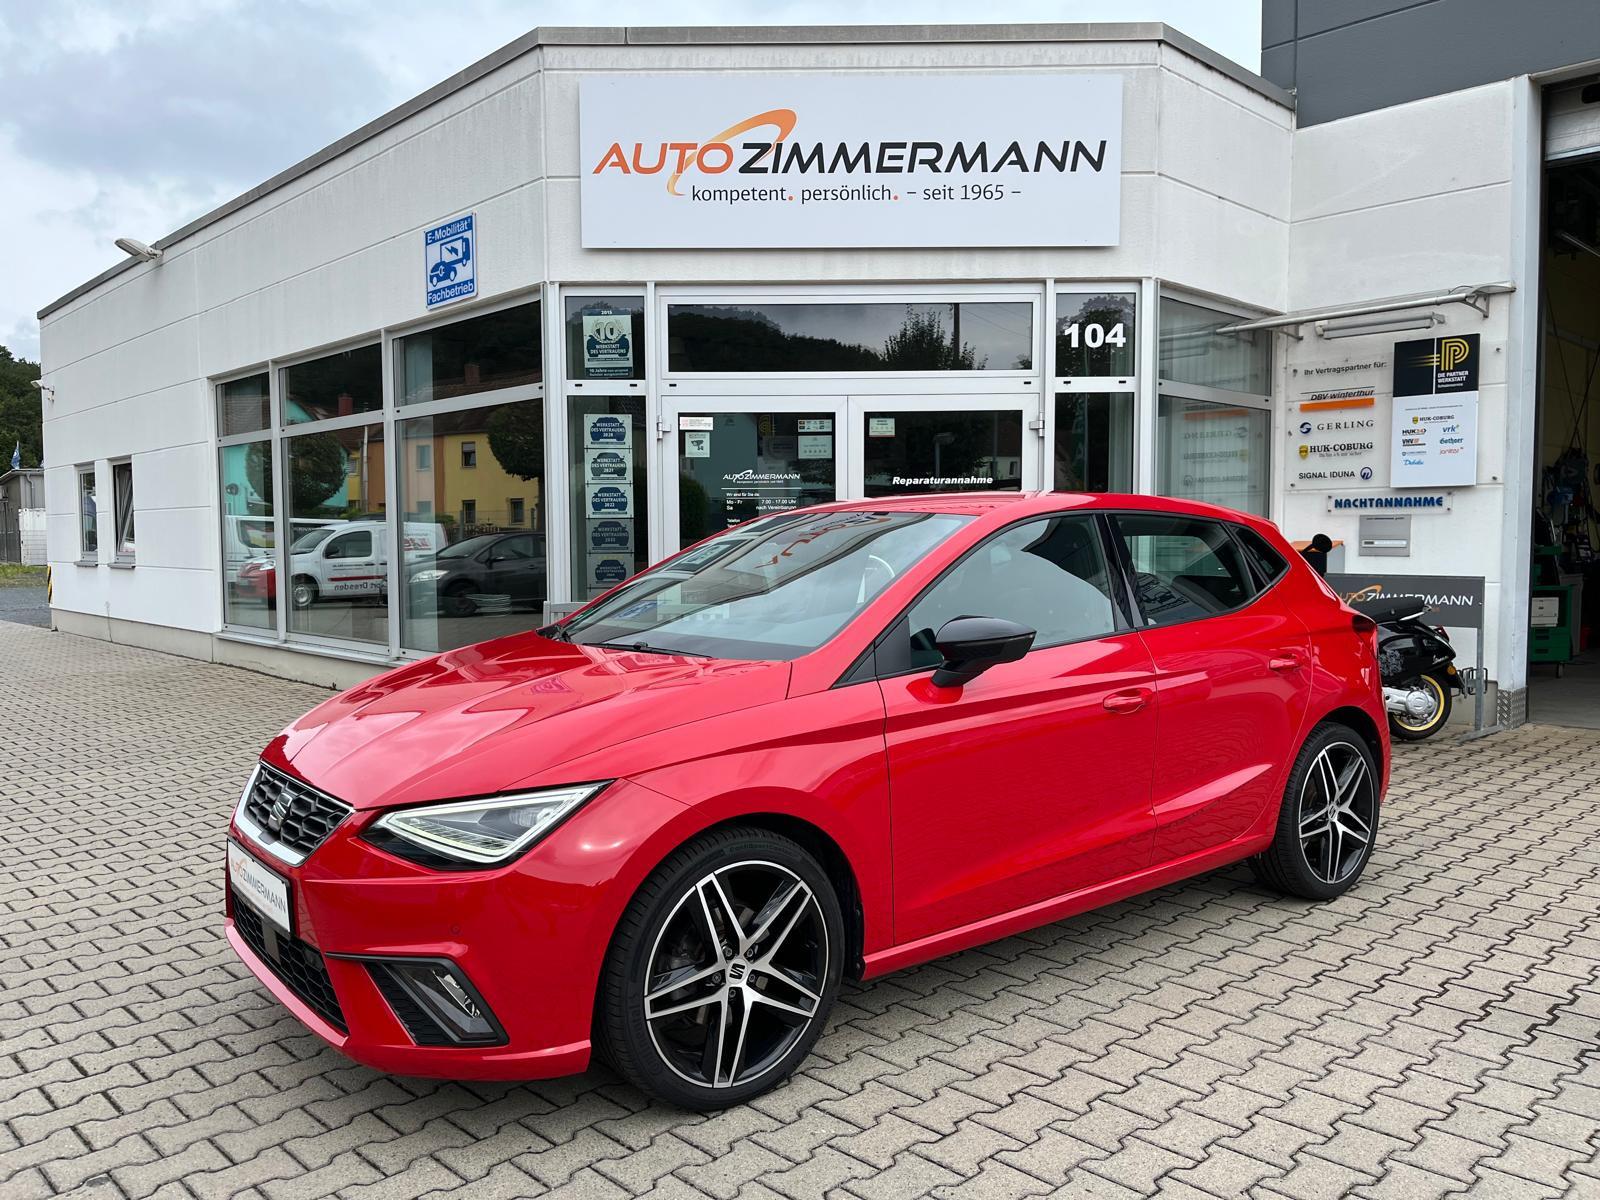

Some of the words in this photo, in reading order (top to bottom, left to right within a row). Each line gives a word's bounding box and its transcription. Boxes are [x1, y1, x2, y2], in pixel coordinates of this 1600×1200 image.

[692, 185, 794, 205] kompetent.
[802, 184, 899, 205] persönlich.
[923, 184, 955, 200] seit
[961, 184, 1004, 200] 1965
[427, 281, 474, 303] Fachbetrieb
[1064, 323, 1127, 348] 104
[1316, 363, 1372, 374] Vertragspartner
[1317, 420, 1374, 431] GERLING
[1310, 442, 1373, 453] HUK-COBURG
[892, 476, 994, 487] Reparaturannahme
[1298, 472, 1328, 480] SIGNAL
[1334, 496, 1443, 509] NACHTANNAHME
